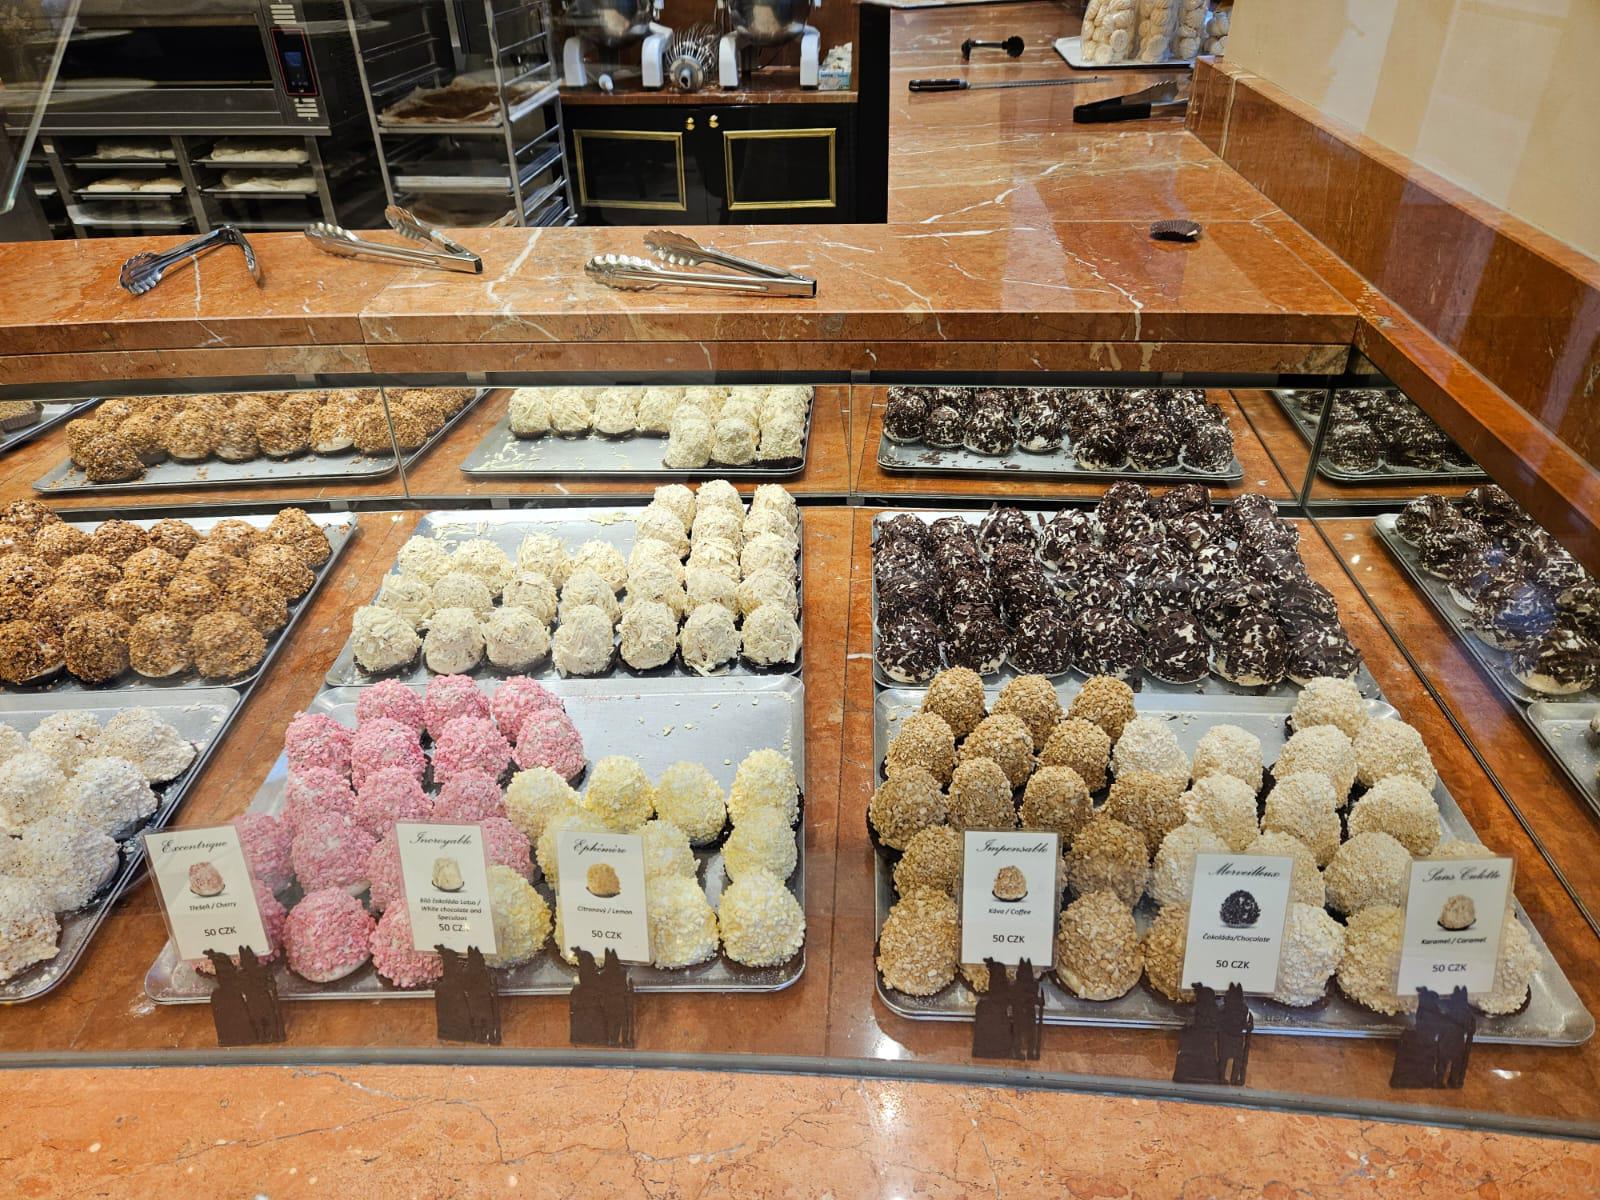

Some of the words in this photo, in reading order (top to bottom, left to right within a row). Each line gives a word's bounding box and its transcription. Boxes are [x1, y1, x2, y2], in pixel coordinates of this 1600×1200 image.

[409, 831, 472, 849] Incroyable
[161, 839, 228, 854] Excentrique
[976, 839, 1049, 856] Impensable
[1208, 862, 1281, 877] Merveilleux
[1422, 867, 1455, 882] Sans
[216, 901, 237, 909] Cherry
[204, 928, 216, 937] 50
[218, 926, 237, 936] CZK
[439, 923, 450, 931] 50
[591, 930, 603, 938] 50
[605, 931, 622, 939] CZK
[992, 935, 1004, 943] 50
[1007, 935, 1025, 943] CZK
[1216, 960, 1228, 968] 50
[1231, 960, 1250, 969] CZK
[1432, 964, 1445, 973] 50
[1447, 963, 1467, 972] CZK
